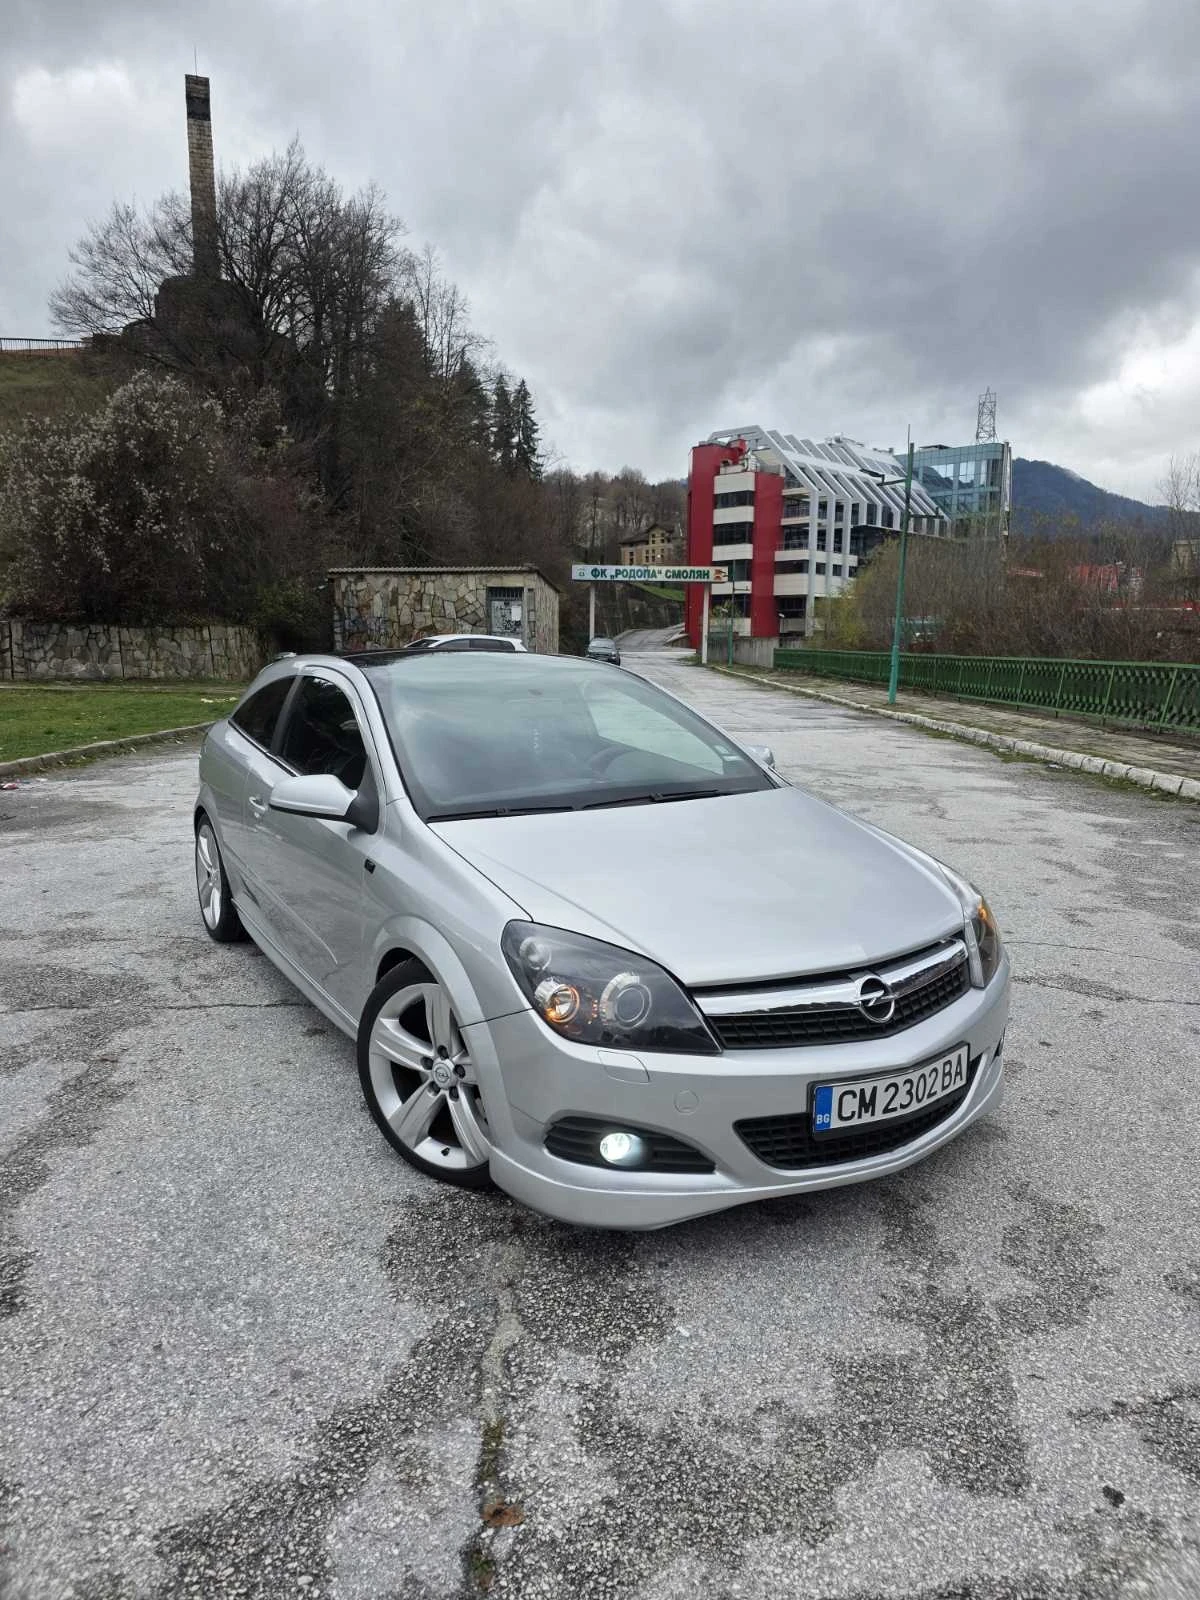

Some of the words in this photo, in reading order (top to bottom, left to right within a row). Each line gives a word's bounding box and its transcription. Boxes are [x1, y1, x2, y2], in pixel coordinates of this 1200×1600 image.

[590, 567, 607, 579] ФК
[664, 569, 710, 580] СМОЛЯН
[882, 1067, 939, 1115] 2302
[816, 1113, 830, 1125] BG
